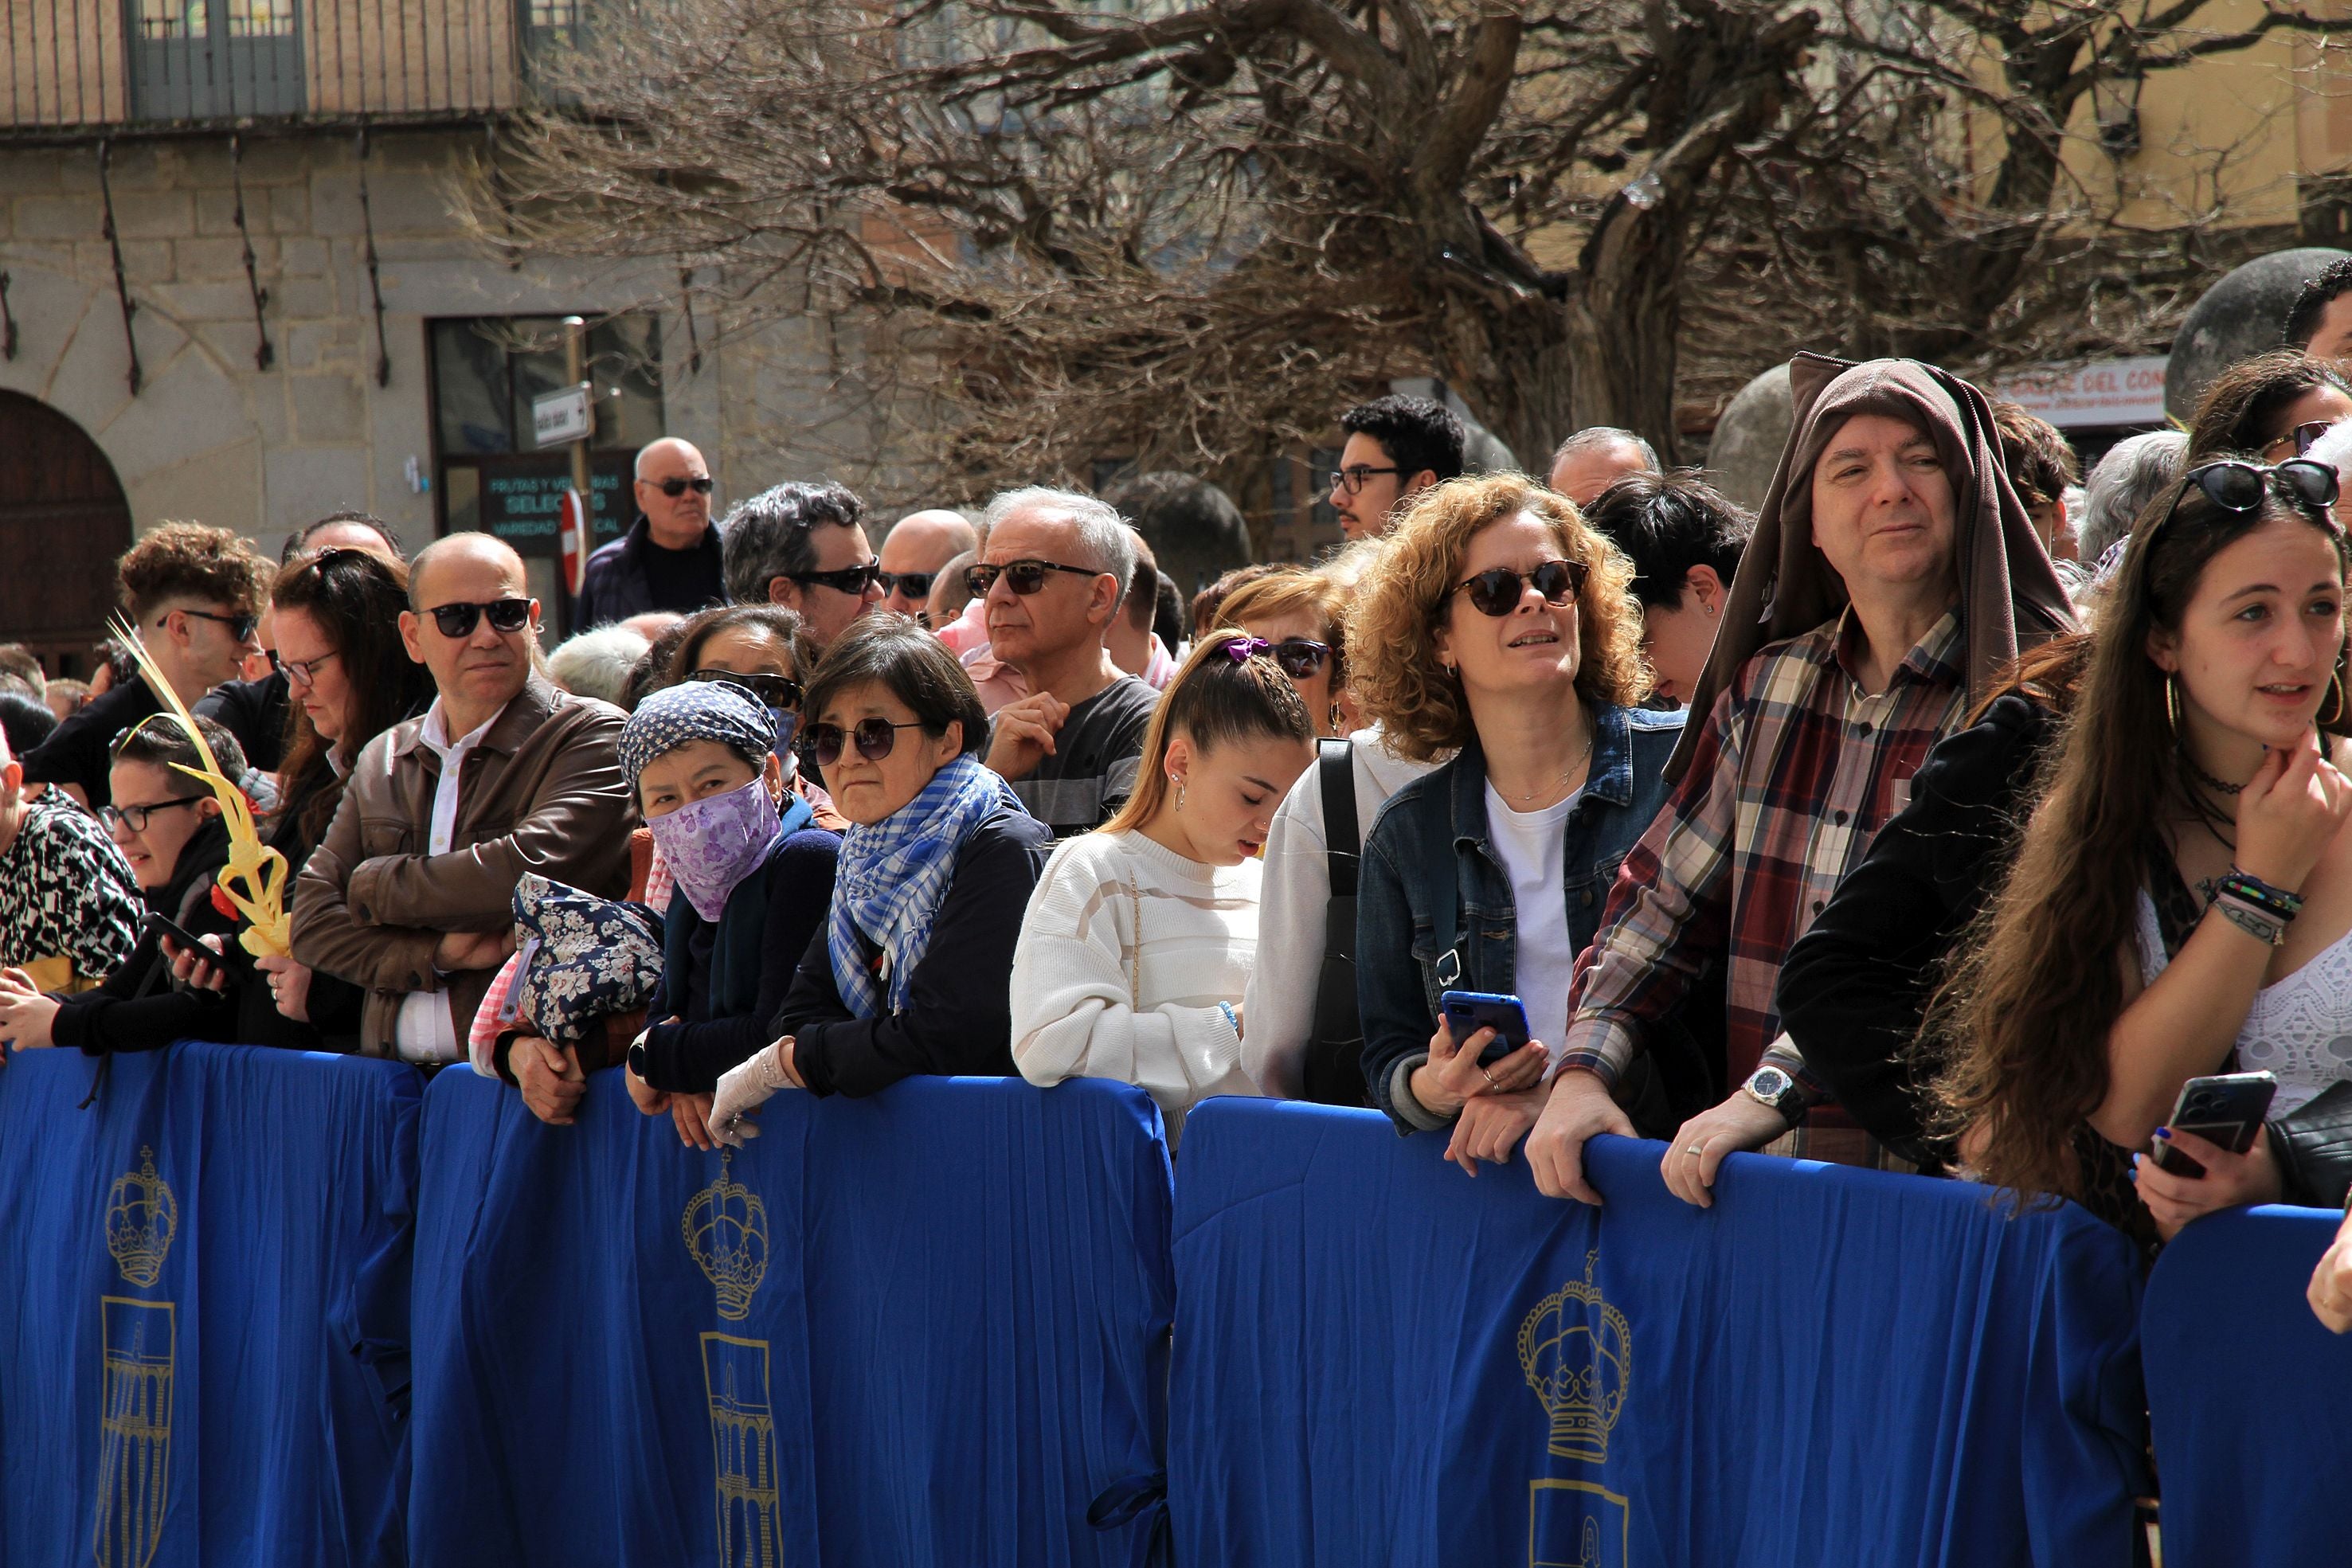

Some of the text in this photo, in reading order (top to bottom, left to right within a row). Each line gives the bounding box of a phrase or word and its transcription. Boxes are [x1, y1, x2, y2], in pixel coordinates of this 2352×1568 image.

[2083, 372, 2119, 393] DEL
[491, 479, 538, 492] FRUTAS
[506, 493, 605, 513] SELECS
[493, 521, 556, 535] VARIEDAD
